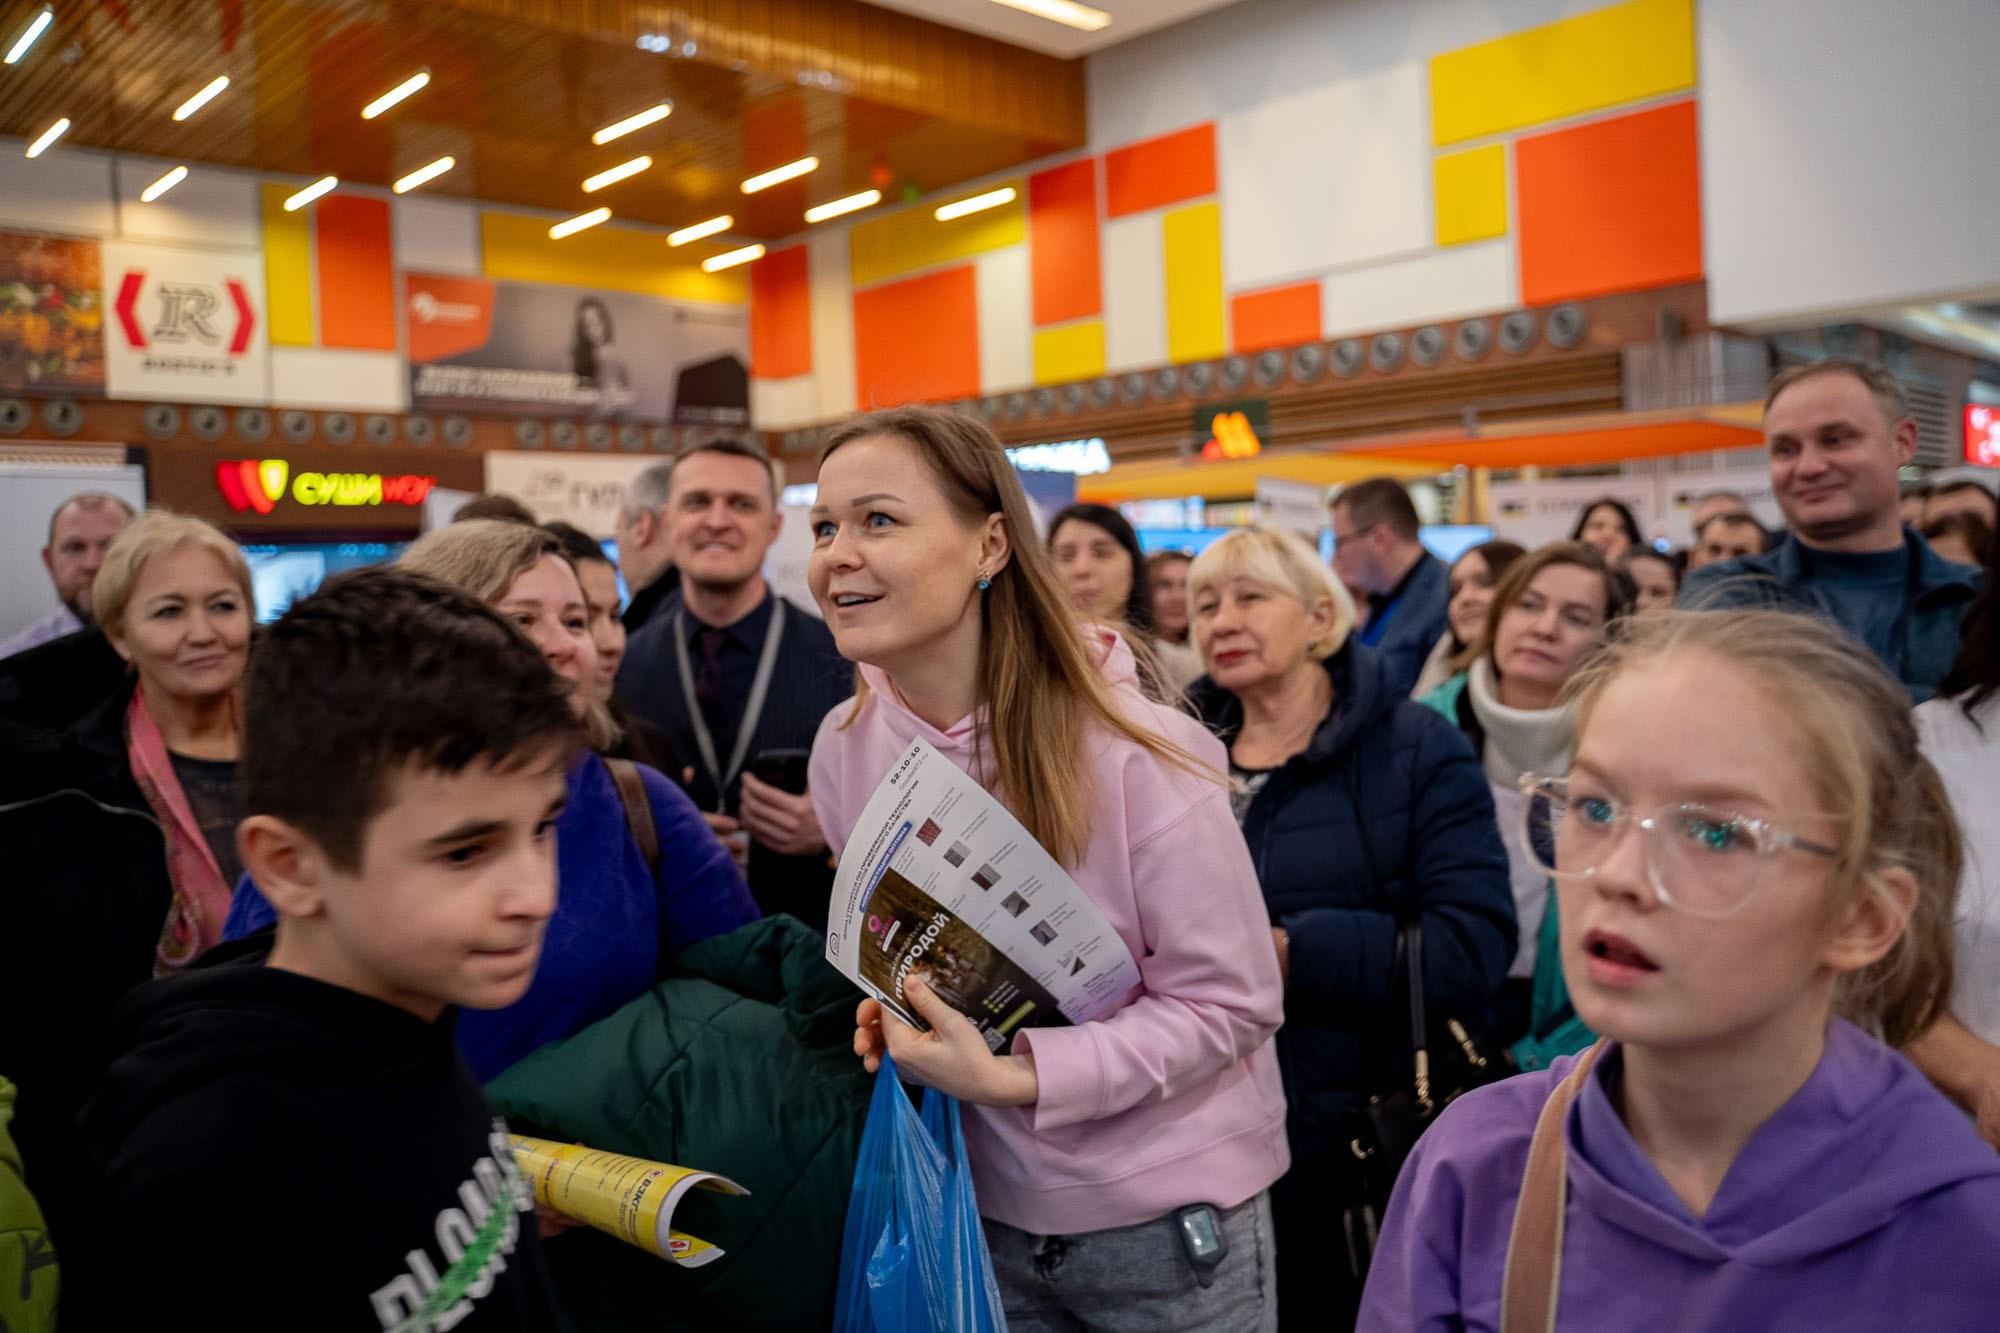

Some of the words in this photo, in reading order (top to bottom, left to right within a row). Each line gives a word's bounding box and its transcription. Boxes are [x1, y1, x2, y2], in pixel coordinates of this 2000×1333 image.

[890, 746, 921, 785] 52-10-10
[860, 821, 890, 872] ПРОВЕРЕННОЙ
[888, 780, 919, 821] ТЕХНОЛОГИИ
[866, 830, 890, 867] ВЫСОКОГО
[888, 799, 913, 831] КАЧЕСТВА
[861, 852, 891, 908] КОМПЛЕКТАЦИЯ
[895, 912, 950, 1000] ПРИРОДОЙ
